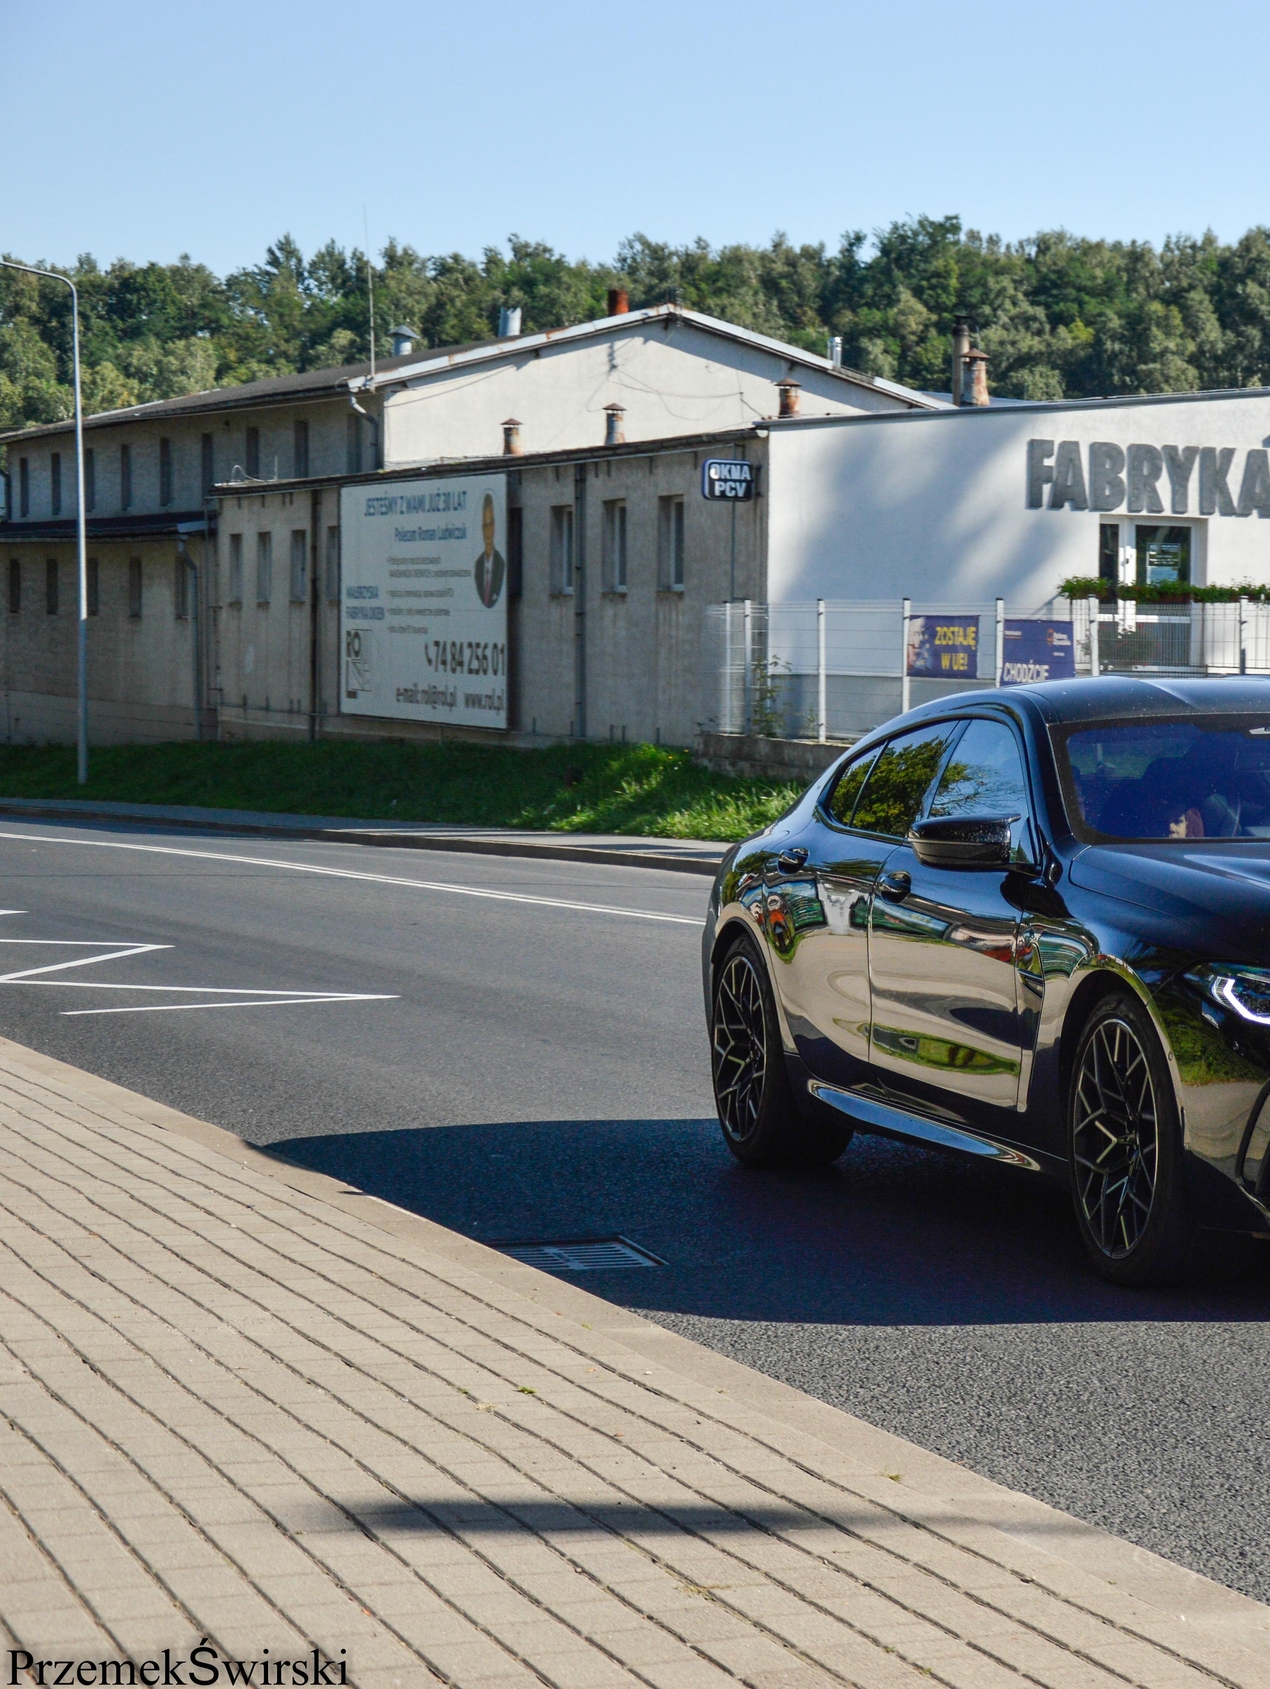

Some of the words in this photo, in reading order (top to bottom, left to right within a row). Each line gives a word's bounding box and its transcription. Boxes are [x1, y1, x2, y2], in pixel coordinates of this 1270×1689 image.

[709, 463, 751, 481] OKNA
[714, 481, 747, 497] PCV
[934, 626, 977, 651] ZOSTAJĘ
[434, 640, 448, 672] 74
[449, 641, 464, 674] 84
[467, 641, 489, 675] 256
[491, 642, 505, 676] 01
[941, 653, 951, 670] W
[952, 652, 968, 670] UE!
